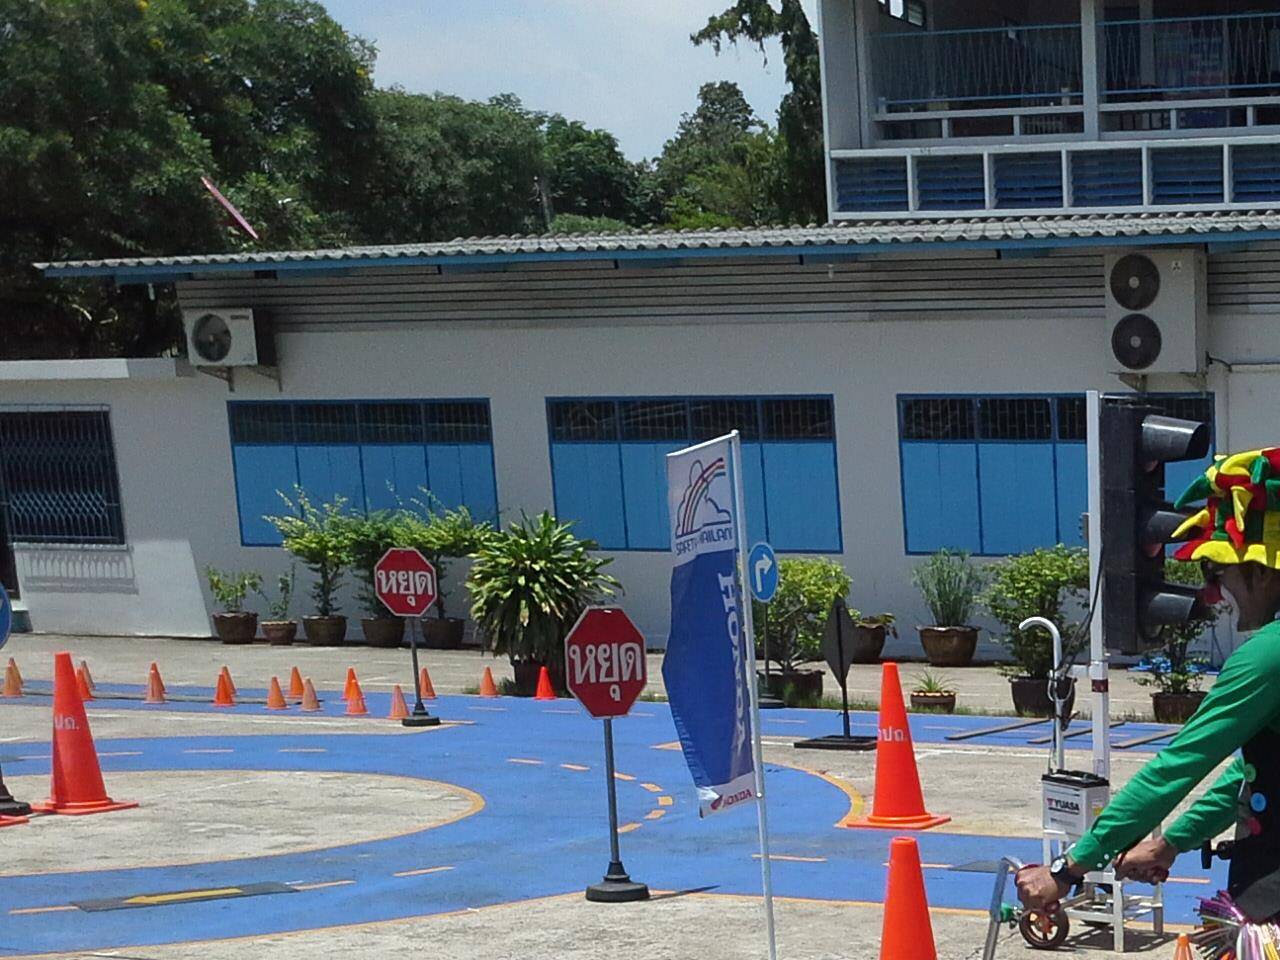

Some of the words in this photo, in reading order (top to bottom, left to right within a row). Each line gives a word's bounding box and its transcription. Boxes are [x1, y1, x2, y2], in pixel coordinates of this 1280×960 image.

[377, 570, 433, 607] หยุด
[569, 642, 643, 701] หยุด
[1055, 799, 1080, 811] YUASA
